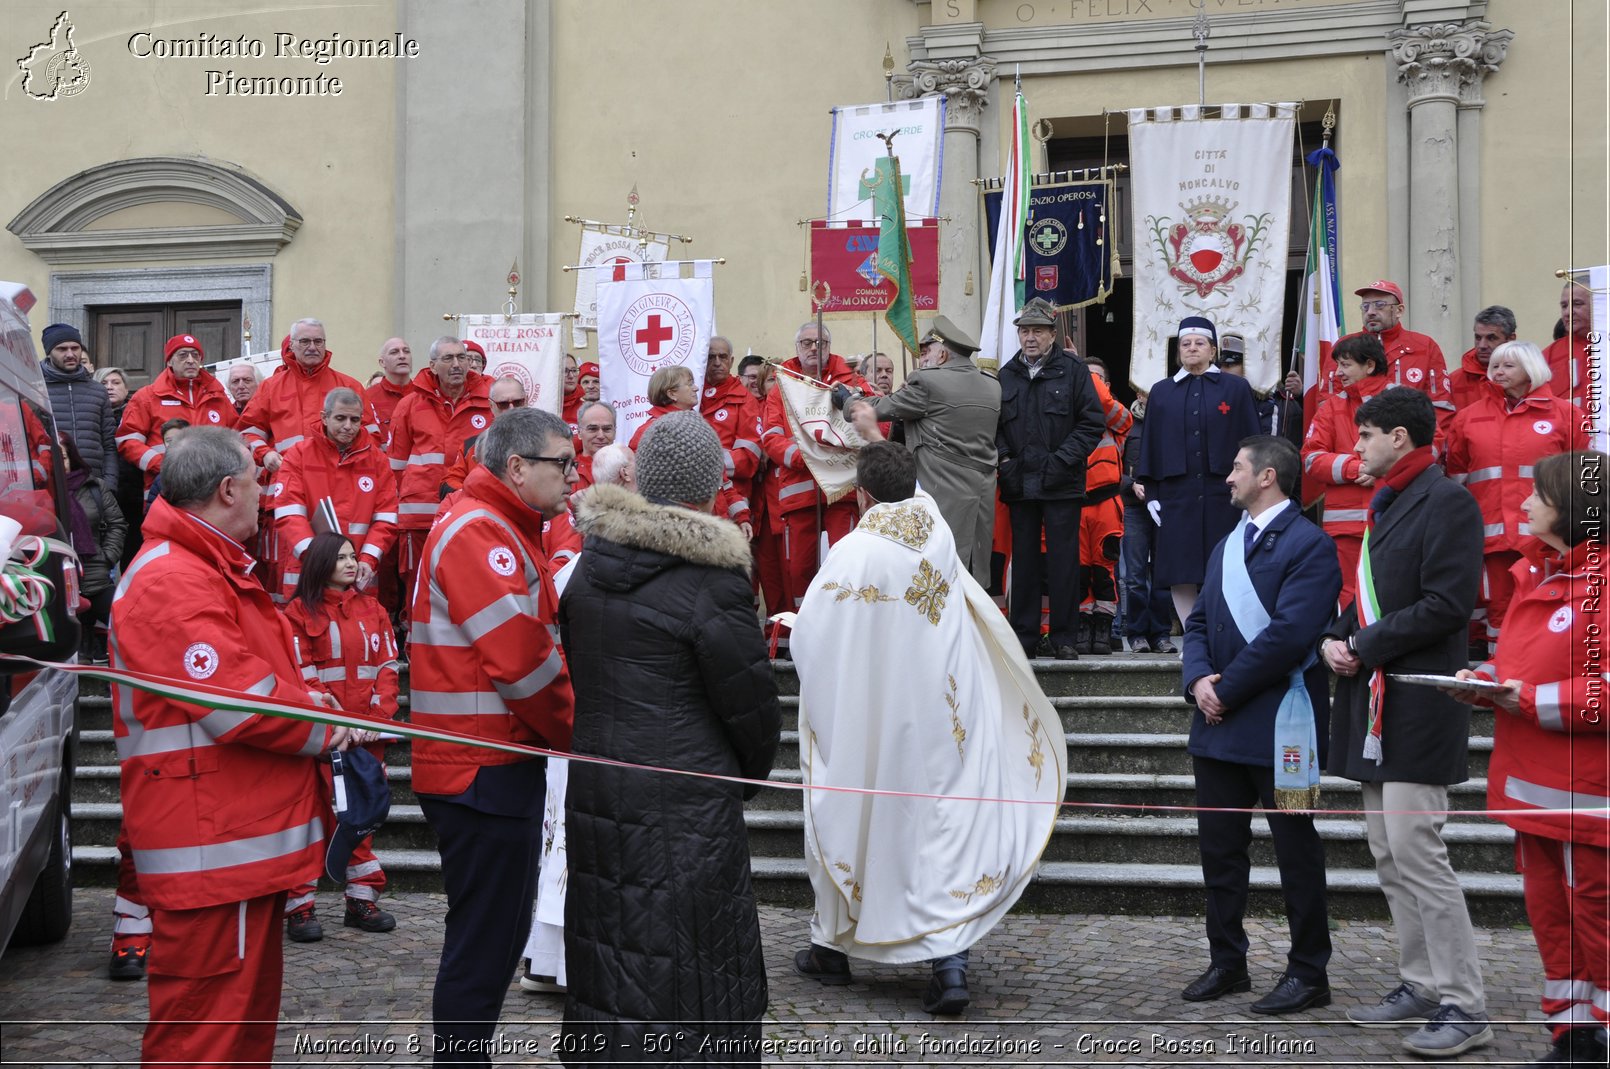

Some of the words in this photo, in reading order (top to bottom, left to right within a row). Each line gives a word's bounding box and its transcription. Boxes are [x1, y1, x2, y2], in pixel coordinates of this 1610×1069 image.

[1203, 164, 1215, 174] DI
[1178, 178, 1240, 192] MONCALVO
[1030, 196, 1056, 206] ENZIO
[1057, 191, 1097, 204] OPEROSA
[605, 240, 632, 251] ROSSA
[881, 257, 899, 273] MO
[638, 295, 678, 312] GINEVRA
[474, 328, 511, 339] CROCE
[516, 327, 554, 339] ROSSA
[486, 341, 541, 353] ITALIANA
[528, 383, 541, 407] CORSO
[634, 395, 650, 405] Ros
[625, 410, 649, 421] COMIT
[805, 406, 833, 418] ROSSA
